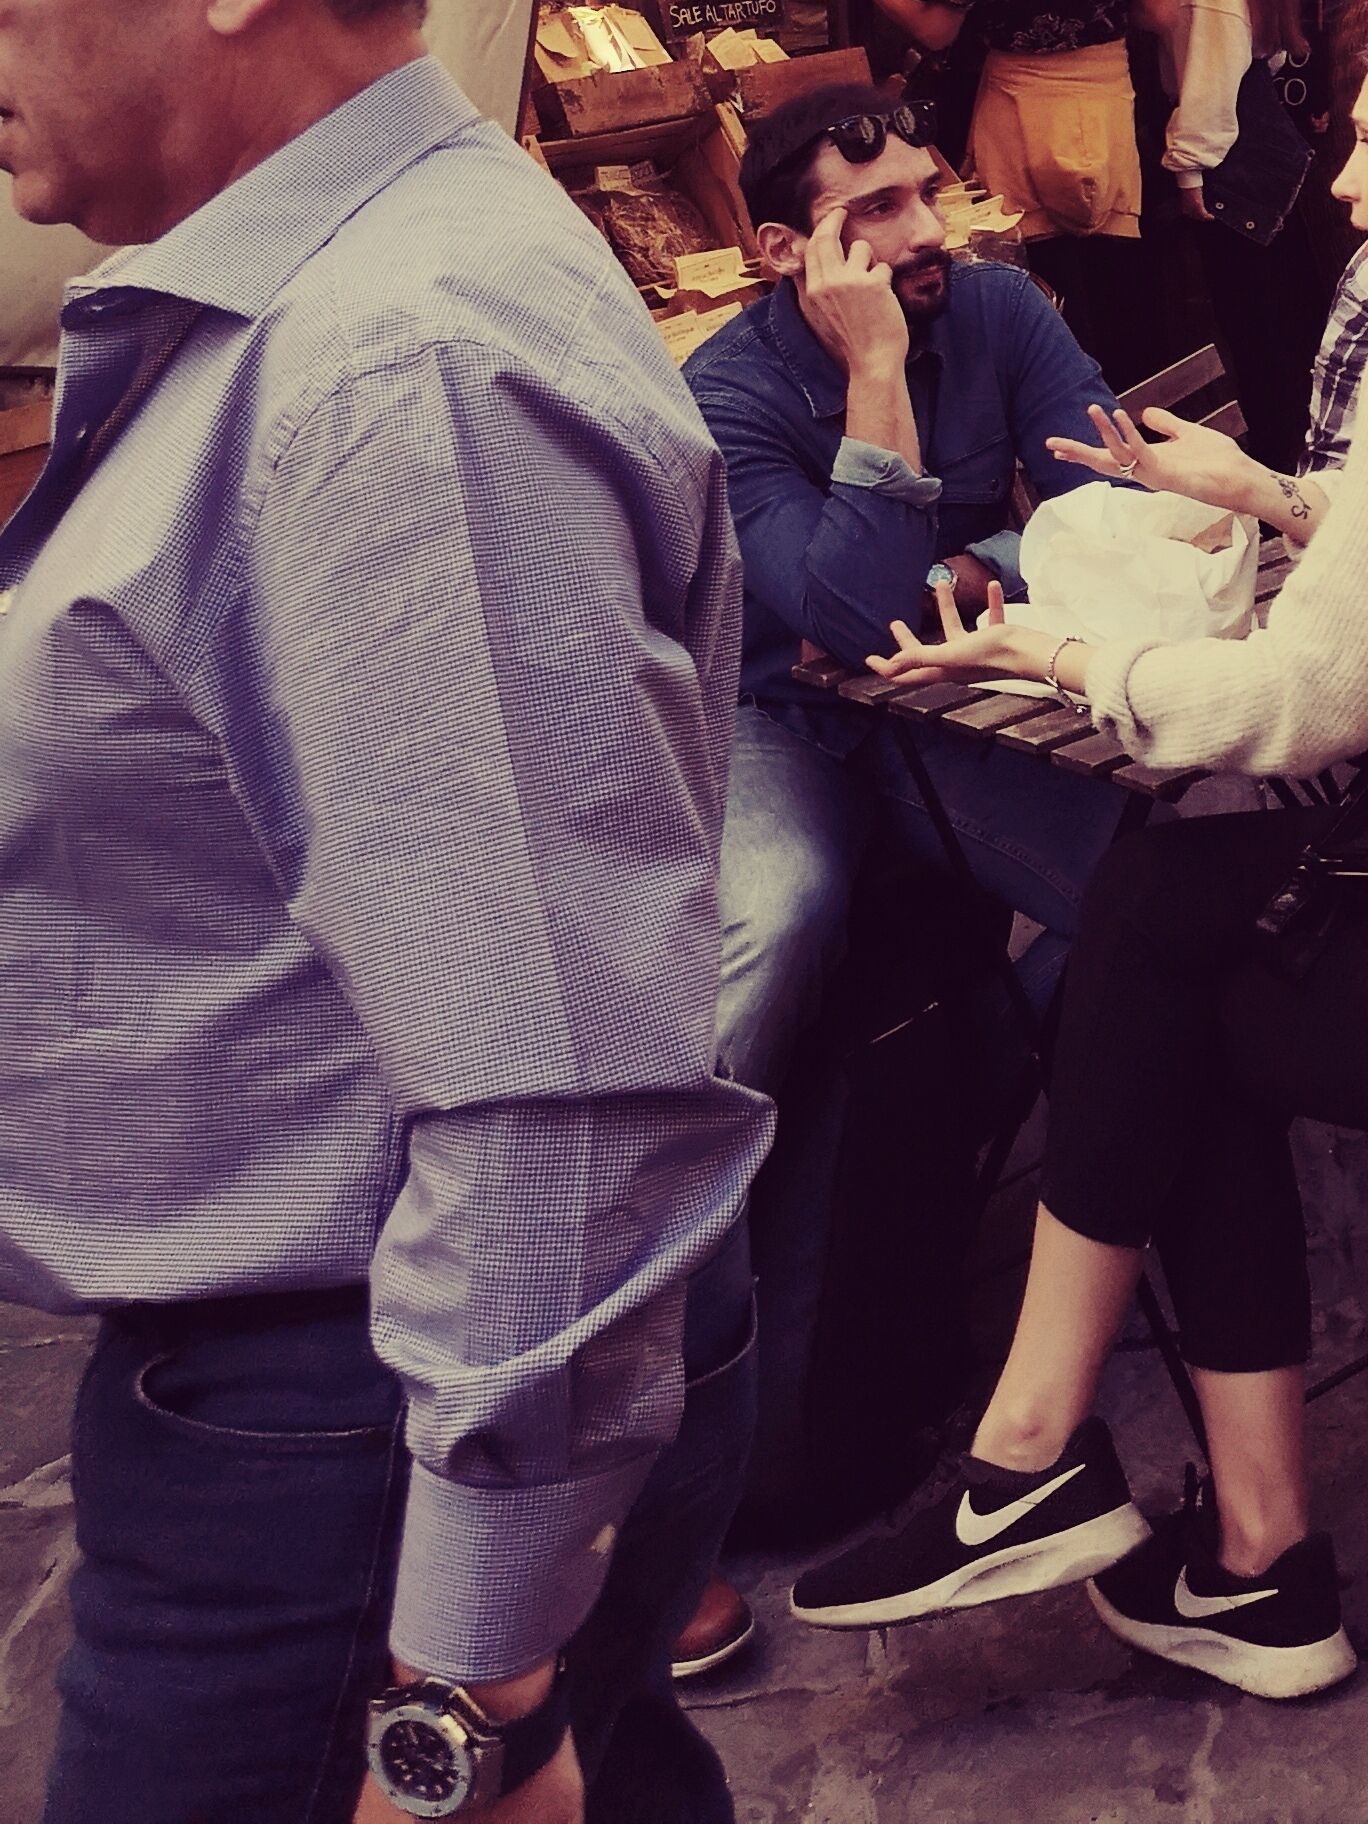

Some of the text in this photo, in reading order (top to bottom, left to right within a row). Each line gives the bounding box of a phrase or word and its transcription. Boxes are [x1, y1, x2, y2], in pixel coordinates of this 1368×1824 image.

[669, 0, 777, 28] SALE AL TARTUFO
